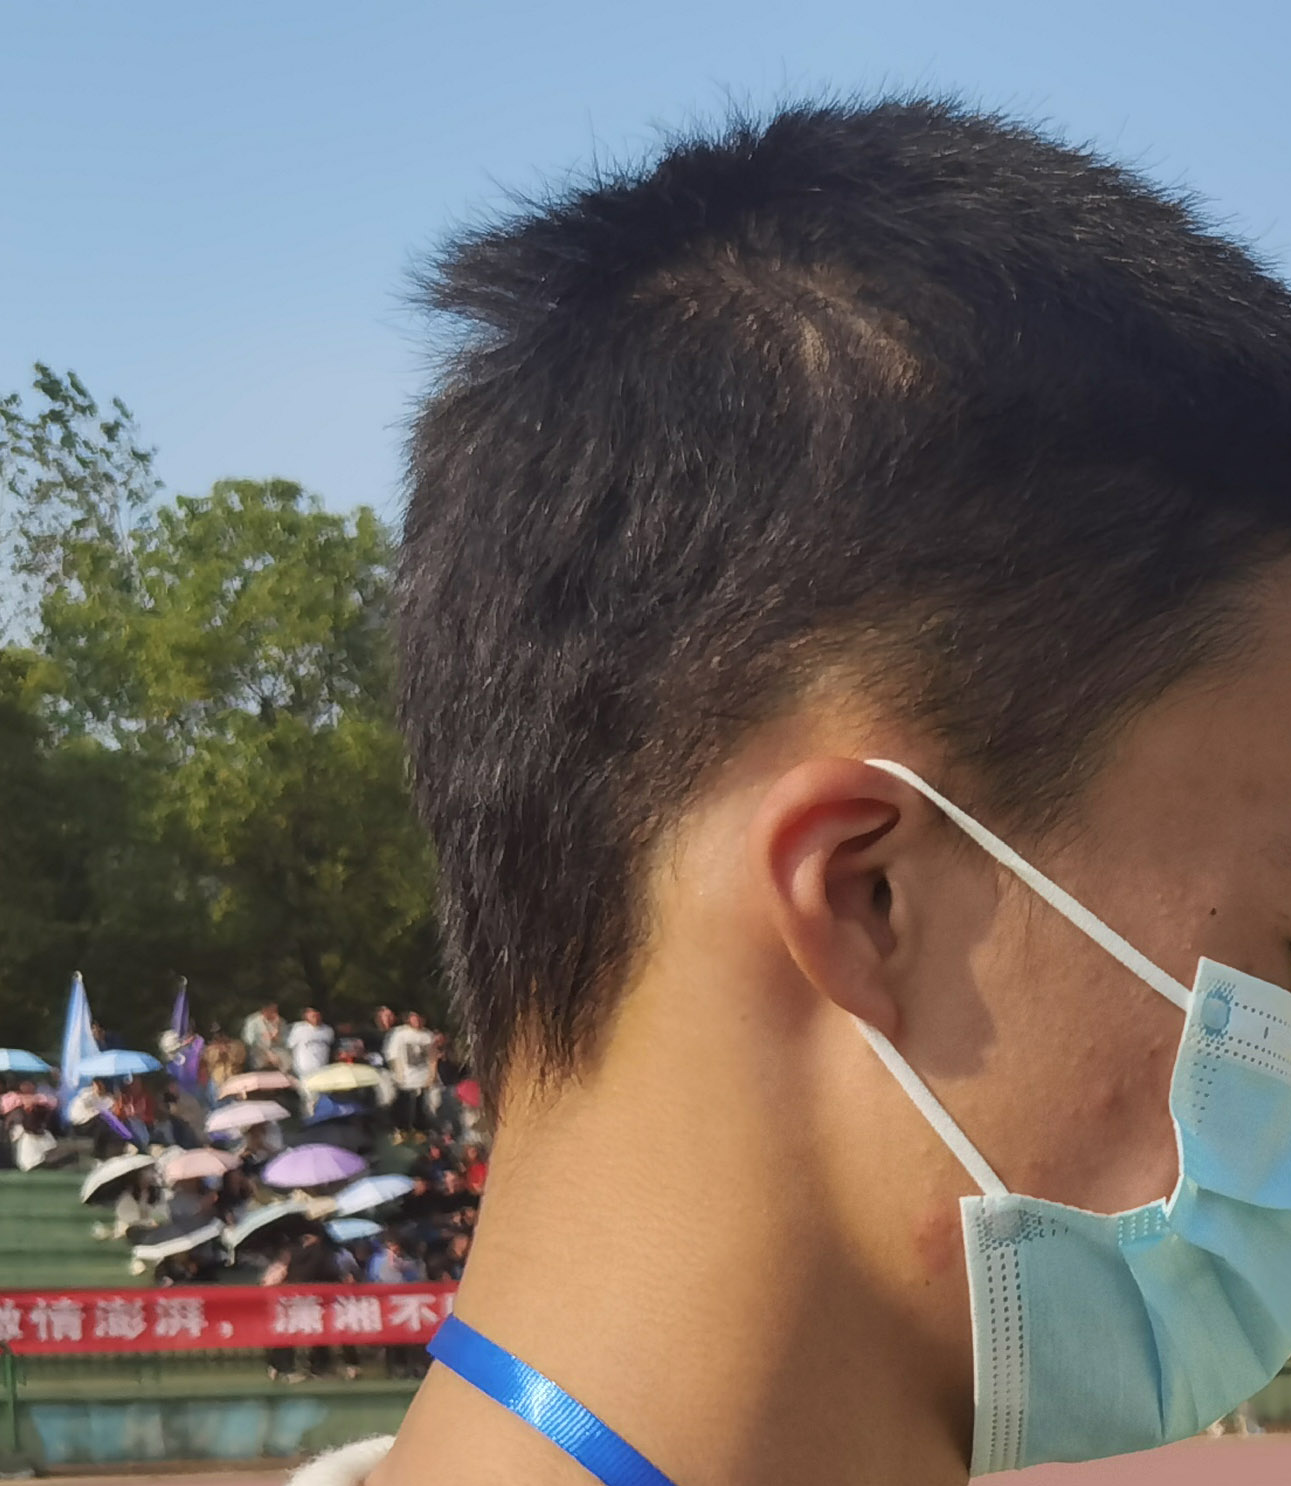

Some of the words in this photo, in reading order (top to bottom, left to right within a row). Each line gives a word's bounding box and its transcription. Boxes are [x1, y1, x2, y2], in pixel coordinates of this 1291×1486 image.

[0, 1293, 454, 1341] 情澎湃，潇湘不
